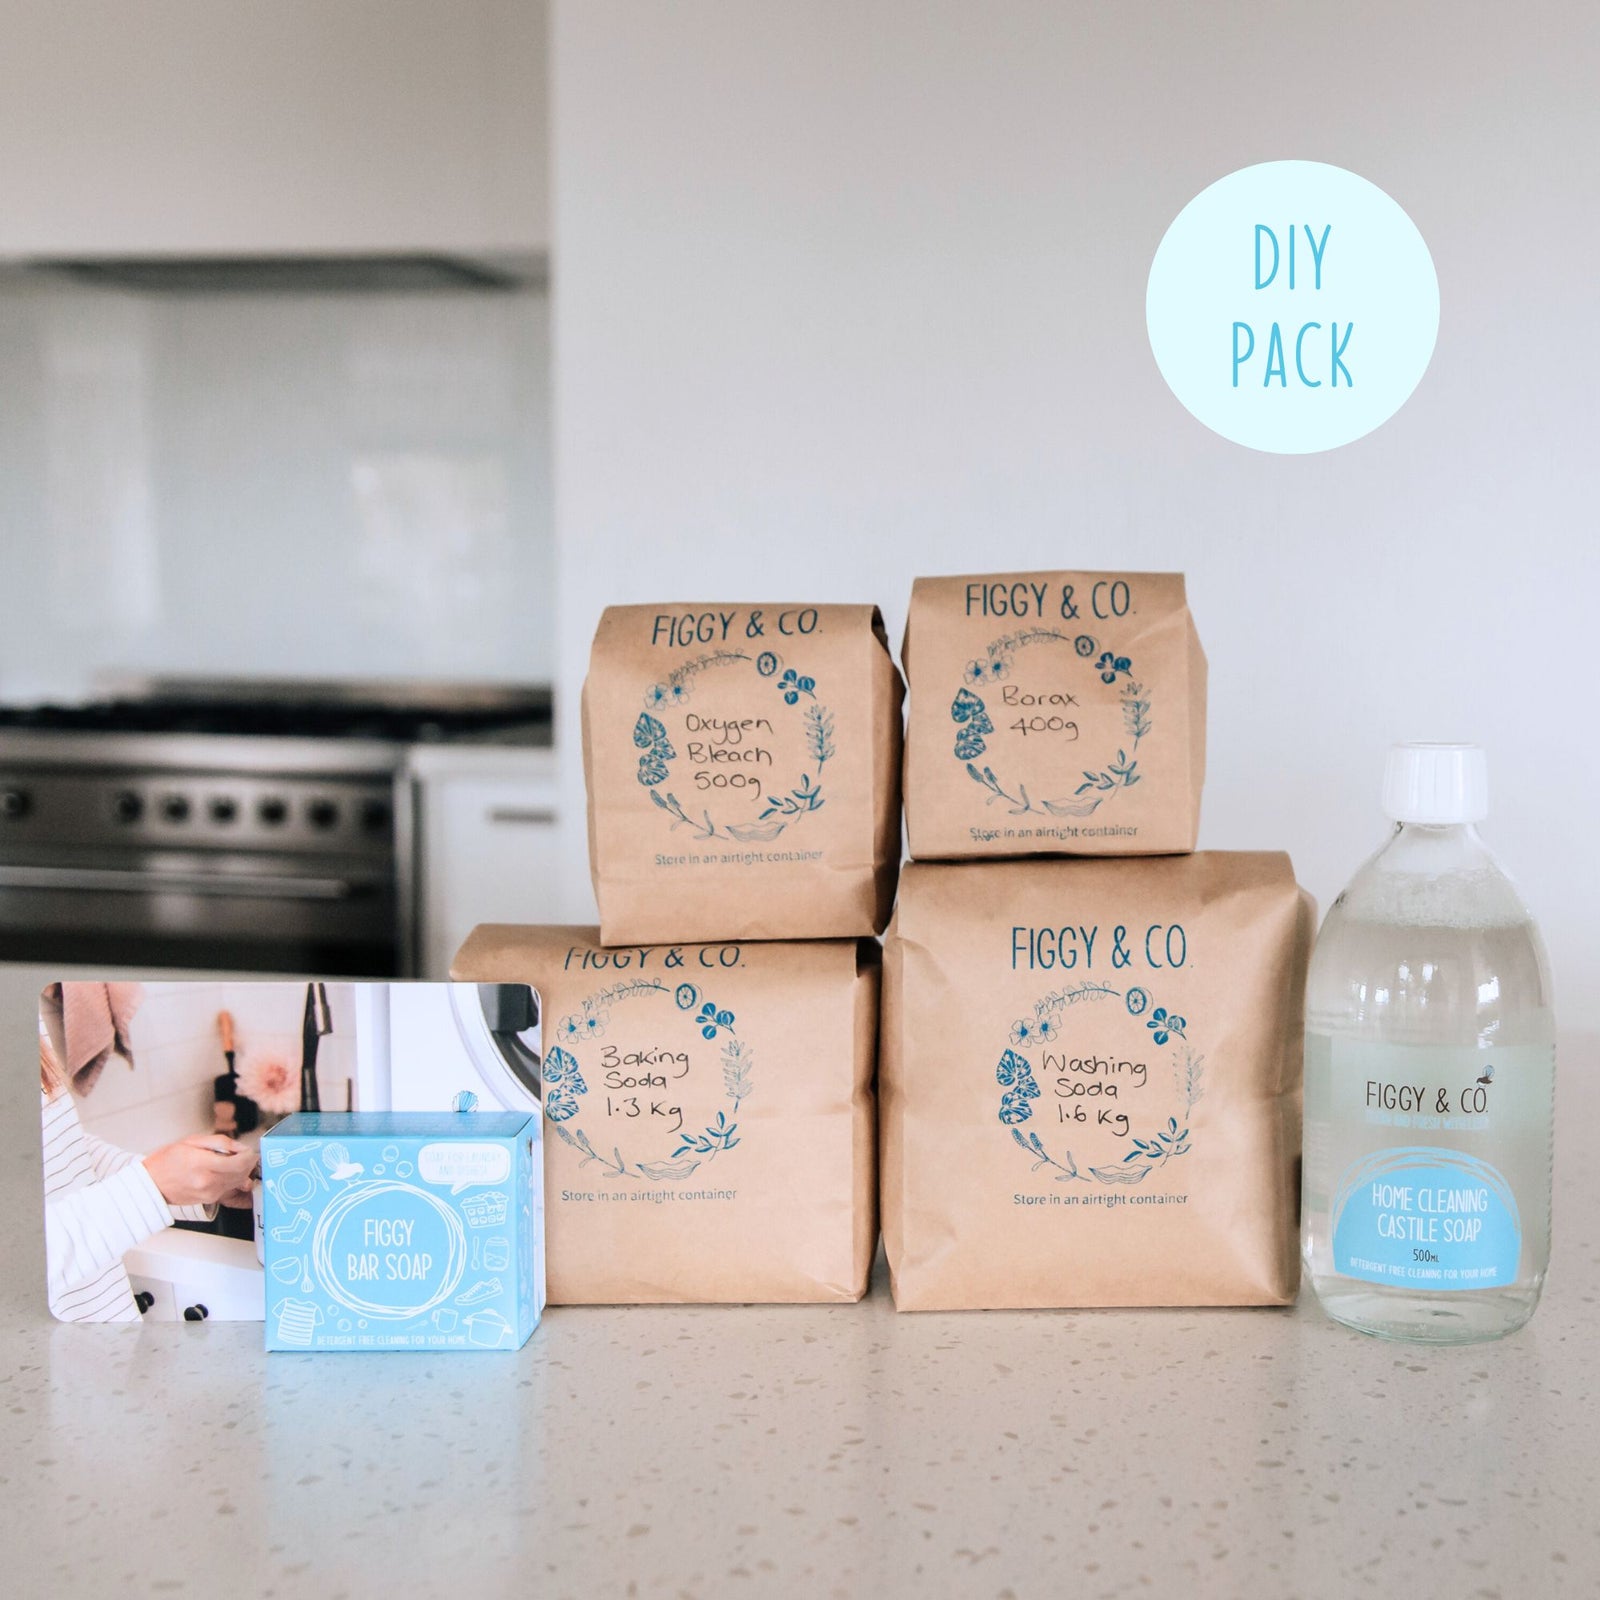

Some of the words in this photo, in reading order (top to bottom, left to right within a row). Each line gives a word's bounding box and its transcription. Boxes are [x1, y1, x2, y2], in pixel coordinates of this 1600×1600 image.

[966, 583, 1048, 617] FIGGY
[1060, 584, 1080, 619] &
[1092, 581, 1137, 619] CO.
[652, 611, 736, 647] FIGGY
[745, 610, 765, 638] &
[778, 609, 823, 635] CO.
[1002, 685, 1080, 707] Borax
[686, 713, 774, 745] Oxygen
[1010, 716, 1079, 741] 400g
[686, 742, 772, 766] Bleach
[694, 771, 761, 800] 500g
[1003, 828, 1015, 837] in
[1018, 829, 1033, 837] an
[1035, 826, 1079, 840] airtight
[1081, 825, 1138, 837] container
[655, 853, 686, 865] Store
[688, 852, 700, 865] in
[703, 855, 718, 864] an
[721, 851, 764, 866] airtight
[766, 850, 824, 863] container
[664, 947, 685, 969] &
[698, 946, 746, 969] CO.
[1011, 925, 1098, 969] FIGGY
[1111, 925, 1131, 969] &
[1145, 924, 1194, 969] CO.
[600, 1046, 689, 1078] Baking
[1043, 1050, 1147, 1088] Washing
[603, 1072, 667, 1089] Soda
[1054, 1078, 1118, 1099] Soda
[607, 1097, 641, 1117] 1.3
[1366, 1081, 1426, 1112] FIGGY
[1435, 1087, 1450, 1113] &
[1461, 1087, 1489, 1113] CO.
[1057, 1103, 1087, 1123] 1.6
[562, 1190, 594, 1201] Store
[598, 1190, 609, 1201] in
[612, 1191, 628, 1201] an
[630, 1189, 676, 1204] airtight
[678, 1188, 737, 1200] container
[1014, 1194, 1046, 1205] Store
[1050, 1194, 1061, 1205] in
[1064, 1195, 1079, 1205] an
[1082, 1193, 1126, 1208] airtight
[1129, 1192, 1188, 1205] container
[1372, 1182, 1413, 1212] HOME
[1418, 1188, 1488, 1213] CLEANING
[364, 1219, 415, 1247] FIGGY
[1378, 1213, 1438, 1242] CASTILE
[1443, 1217, 1482, 1242] SOAP
[347, 1253, 379, 1281] BAR
[386, 1252, 433, 1281] SOAP
[1350, 1257, 1387, 1274] DETERGENT
[1389, 1265, 1406, 1277] FREE
[1408, 1267, 1442, 1279] CLEANING
[1444, 1268, 1458, 1279] FOR
[1461, 1268, 1479, 1279] YOUR
[1480, 1266, 1498, 1278] HOME
[317, 1335, 356, 1345] DETERGENT
[358, 1335, 376, 1345] FREE
[377, 1335, 409, 1345] CLEANING
[411, 1335, 426, 1345] FOR
[428, 1335, 447, 1345] YOUR
[448, 1335, 466, 1345] HOME
